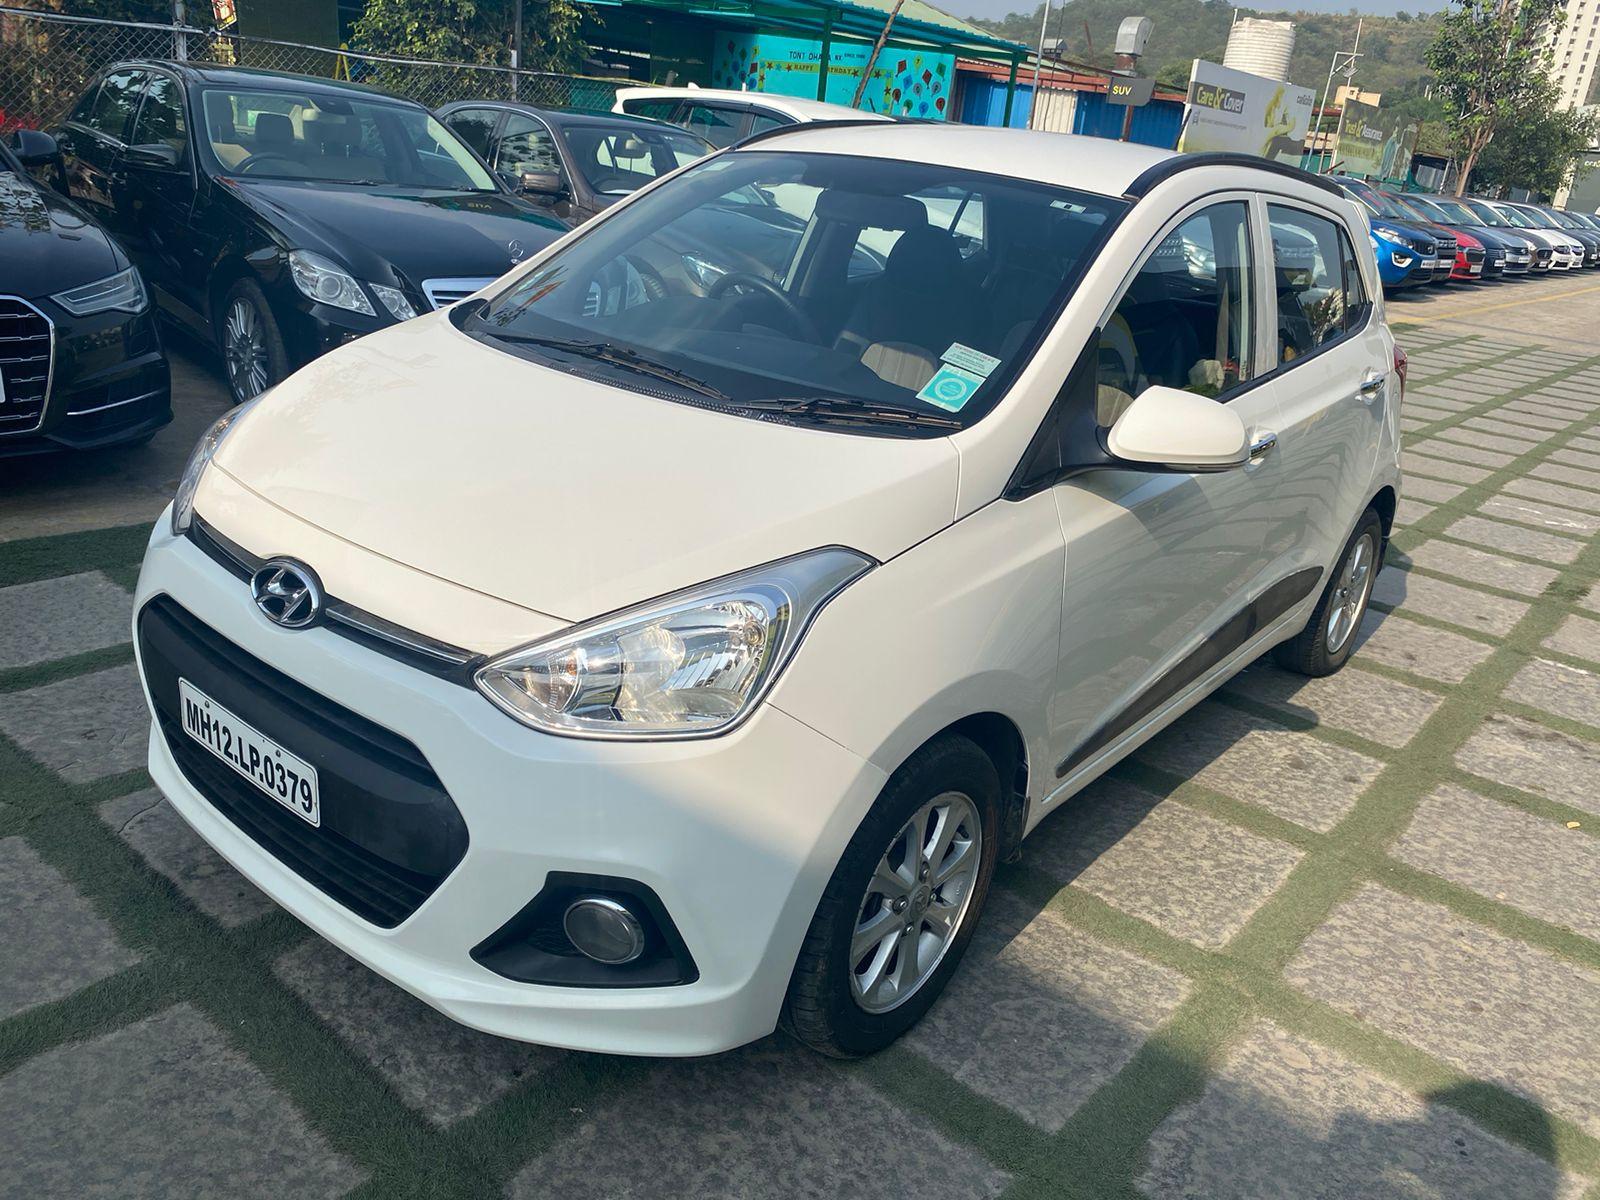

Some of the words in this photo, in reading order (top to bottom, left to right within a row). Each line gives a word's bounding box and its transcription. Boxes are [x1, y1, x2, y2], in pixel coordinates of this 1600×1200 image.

[1112, 85, 1132, 96] SUV
[1197, 86, 1214, 106] Care
[1213, 87, 1225, 109] &
[1224, 92, 1243, 112] Cover
[186, 697, 313, 814] MH12.LP.0379
